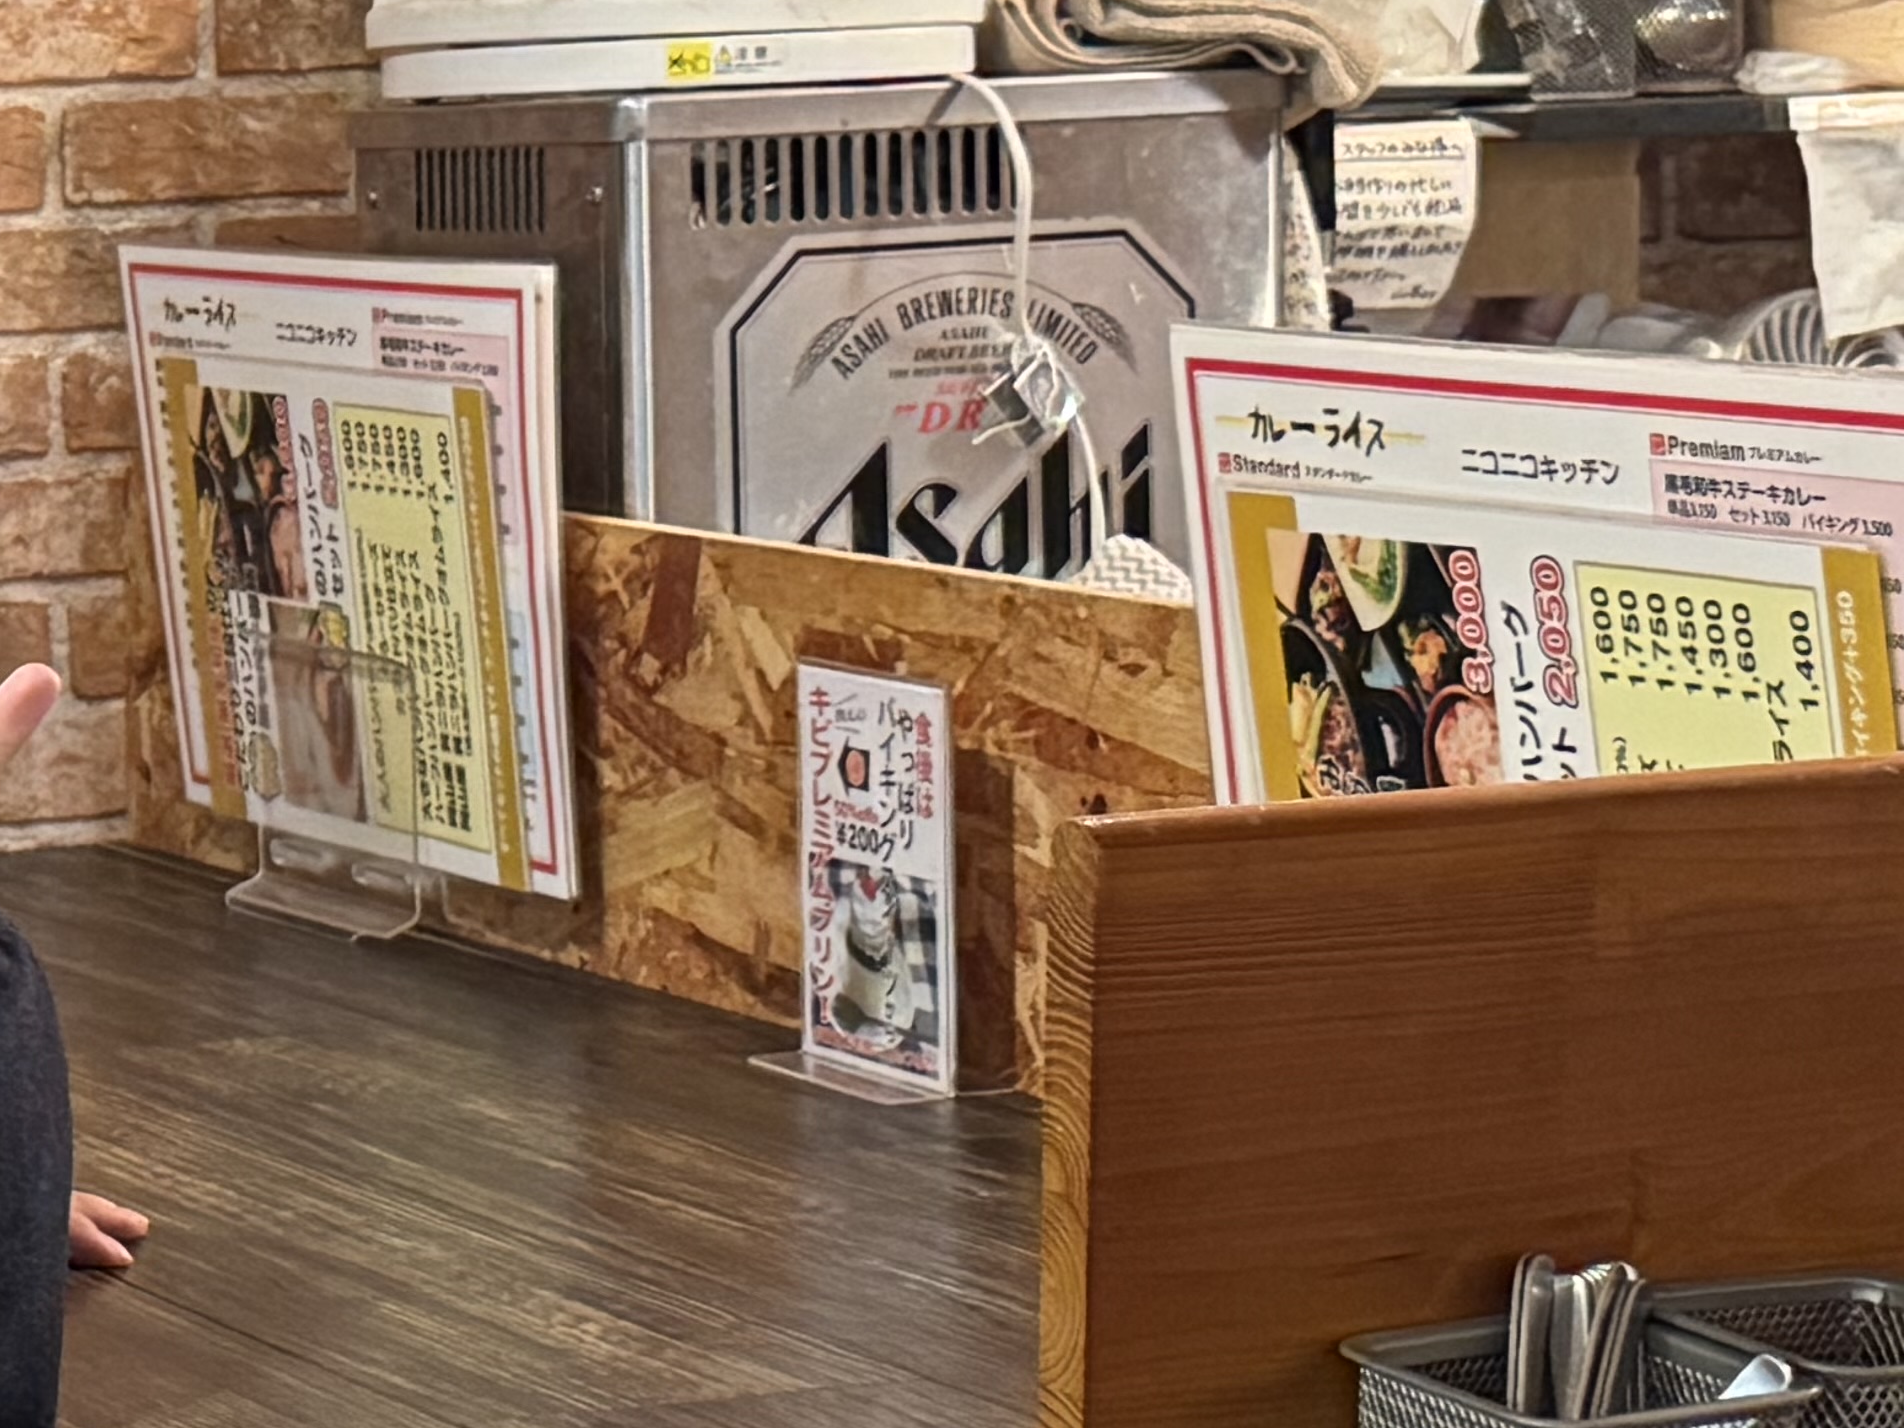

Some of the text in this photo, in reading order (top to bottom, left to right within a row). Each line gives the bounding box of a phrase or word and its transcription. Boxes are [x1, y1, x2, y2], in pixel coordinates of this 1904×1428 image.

[831, 286, 1099, 380] ASAHI BREWERIES LIMITED
[1232, 453, 1301, 480] Standard
[1247, 405, 1620, 486] カレーライス ニコニコキッチン
[1447, 549, 1494, 696] 3,000
[1529, 553, 1580, 709] 2,050
[1589, 586, 1620, 684] 1,600
[1617, 589, 1647, 688] 1,750
[1646, 593, 1676, 691] 1,750
[1674, 596, 1704, 695] 1,450
[1703, 599, 1732, 699] 1,300
[1731, 603, 1761, 703] 1,600
[1789, 610, 1820, 711] 1,400
